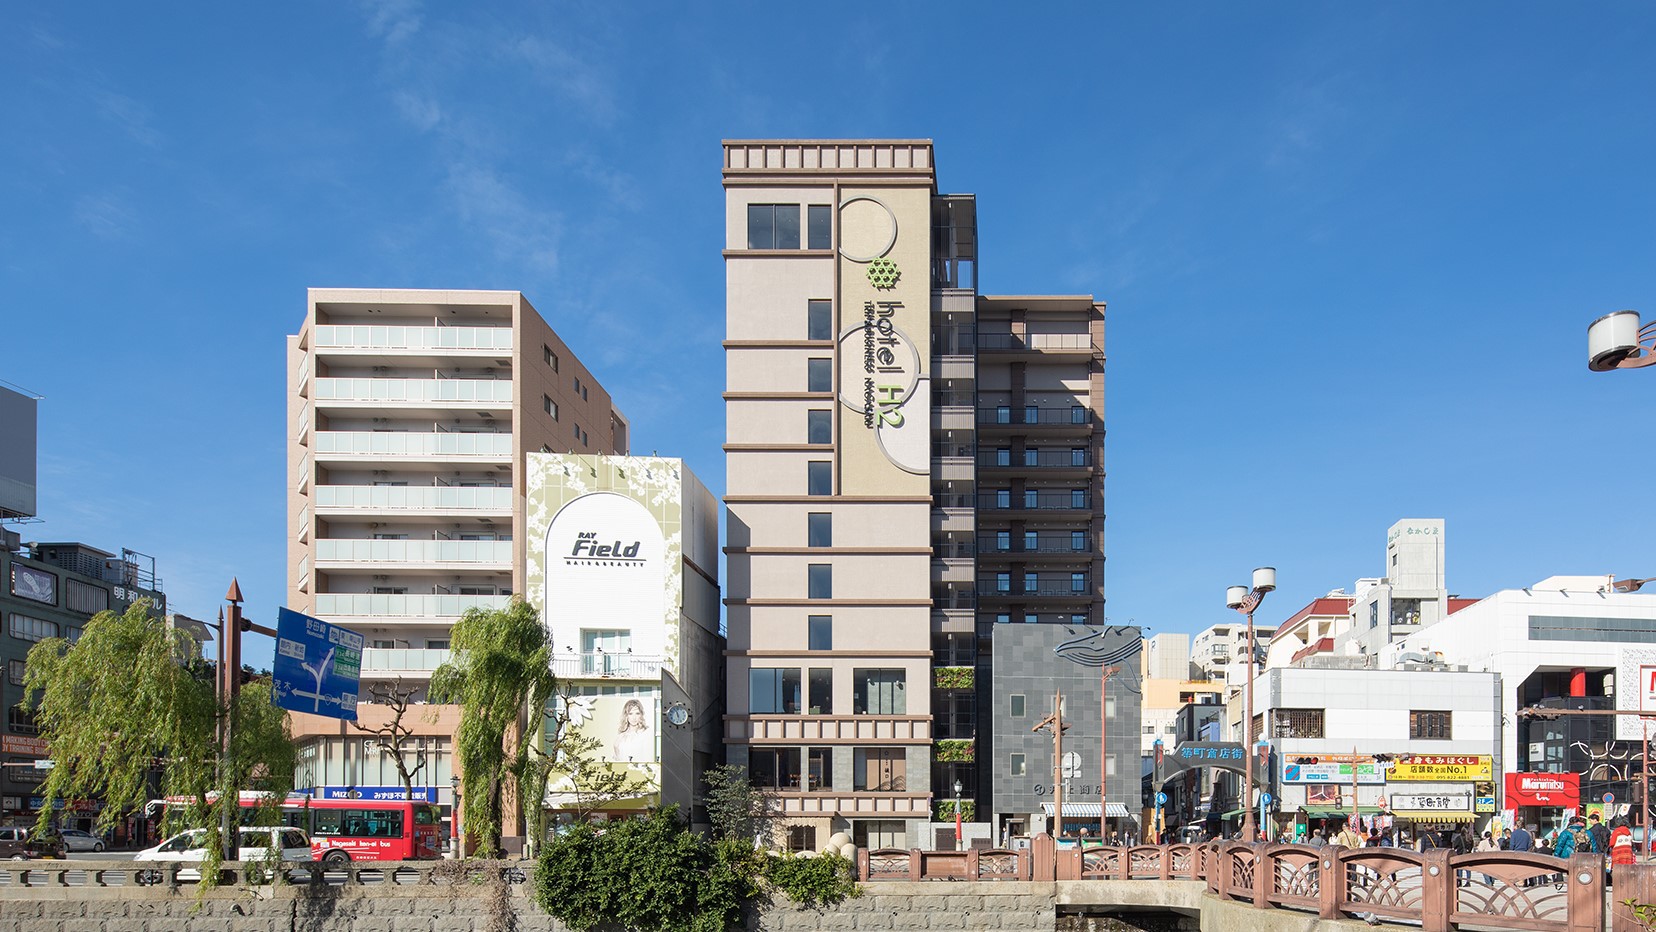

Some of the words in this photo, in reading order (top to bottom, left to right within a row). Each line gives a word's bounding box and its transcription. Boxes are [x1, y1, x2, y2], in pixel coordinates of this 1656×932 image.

[876, 300, 905, 374] hotel
[876, 384, 905, 429] H2
[571, 539, 641, 558] Field
[1181, 747, 1243, 759] 築町商店街
[1522, 778, 1565, 790] Marumitsu
[331, 840, 356, 848] Nagasaki
